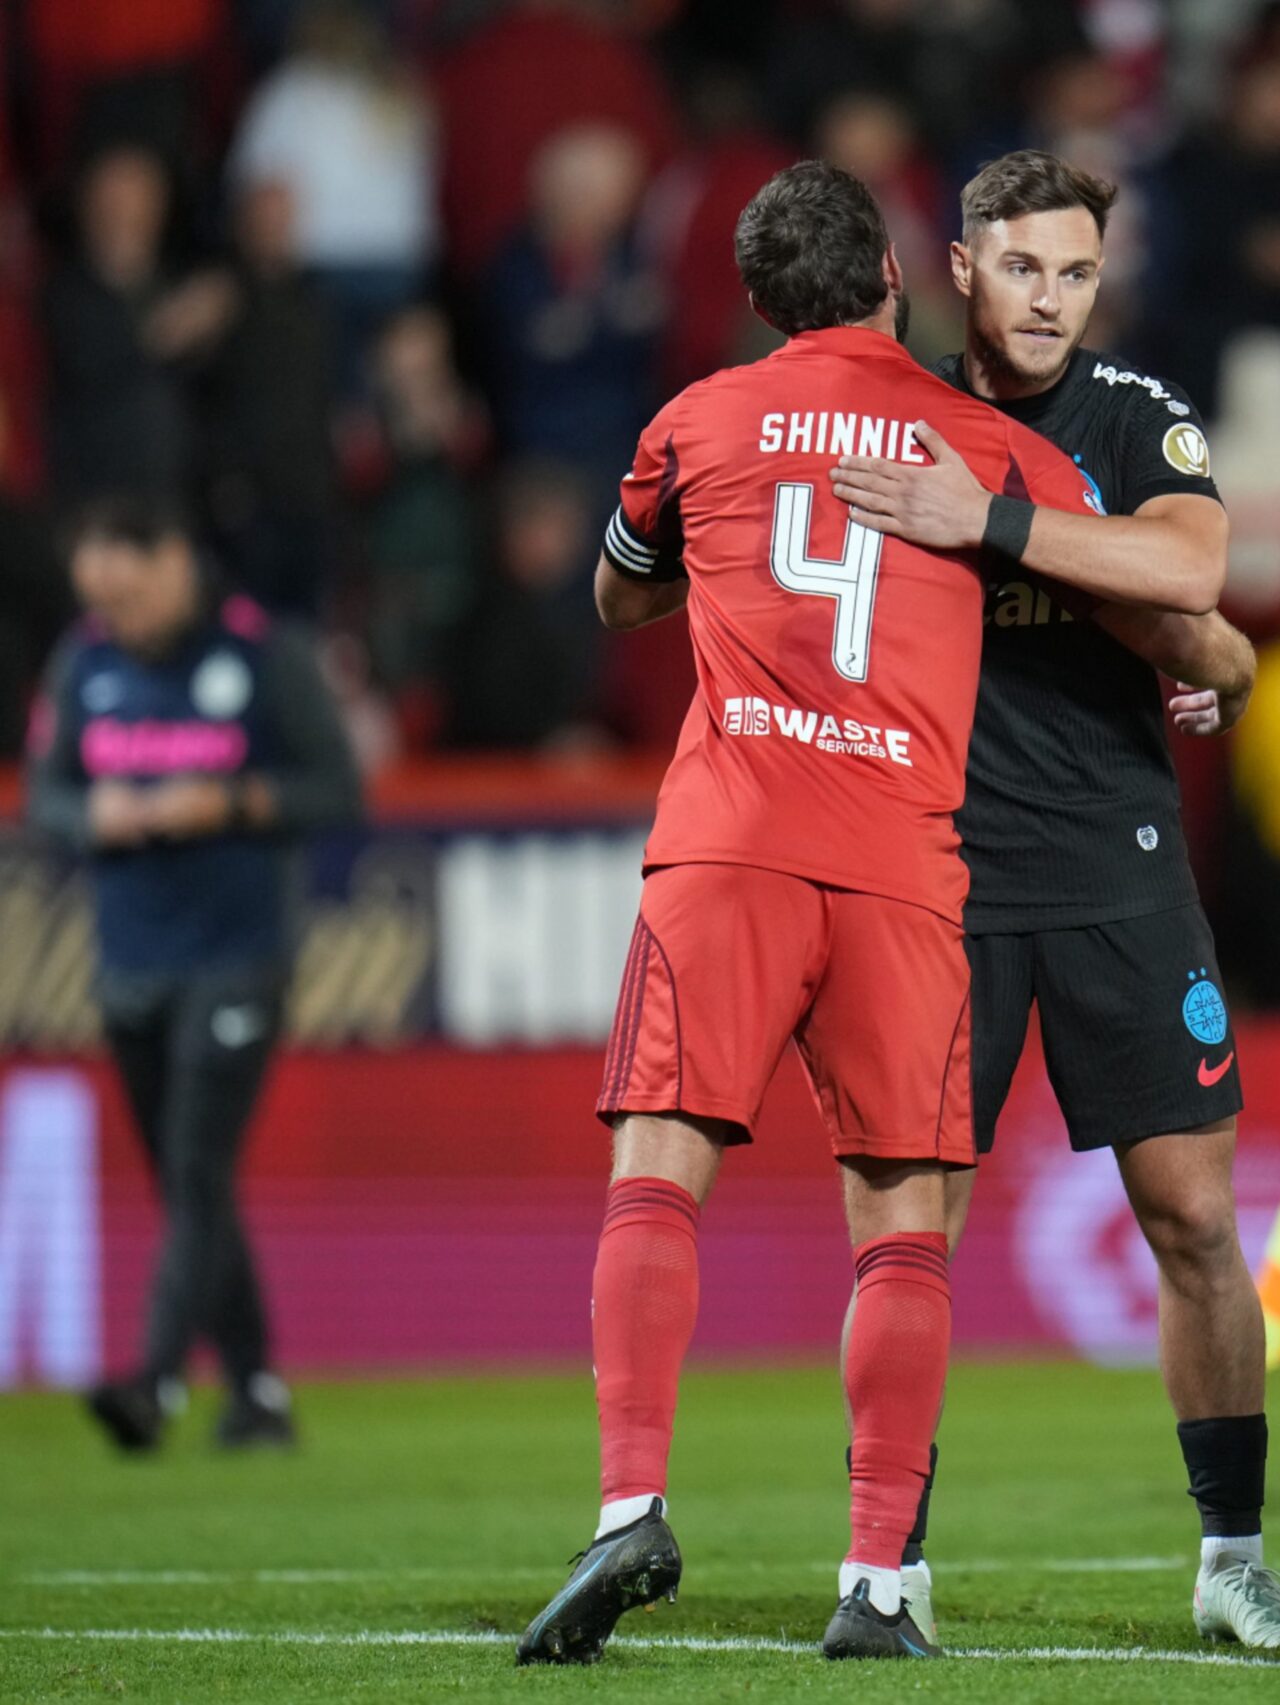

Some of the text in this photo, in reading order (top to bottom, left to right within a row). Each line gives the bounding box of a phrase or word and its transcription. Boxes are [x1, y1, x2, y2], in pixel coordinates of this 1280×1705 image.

[759, 412, 925, 463] SHINNIE
[769, 481, 884, 683] 4
[773, 706, 913, 767] WASTE
[816, 738, 887, 758] SERVICES
